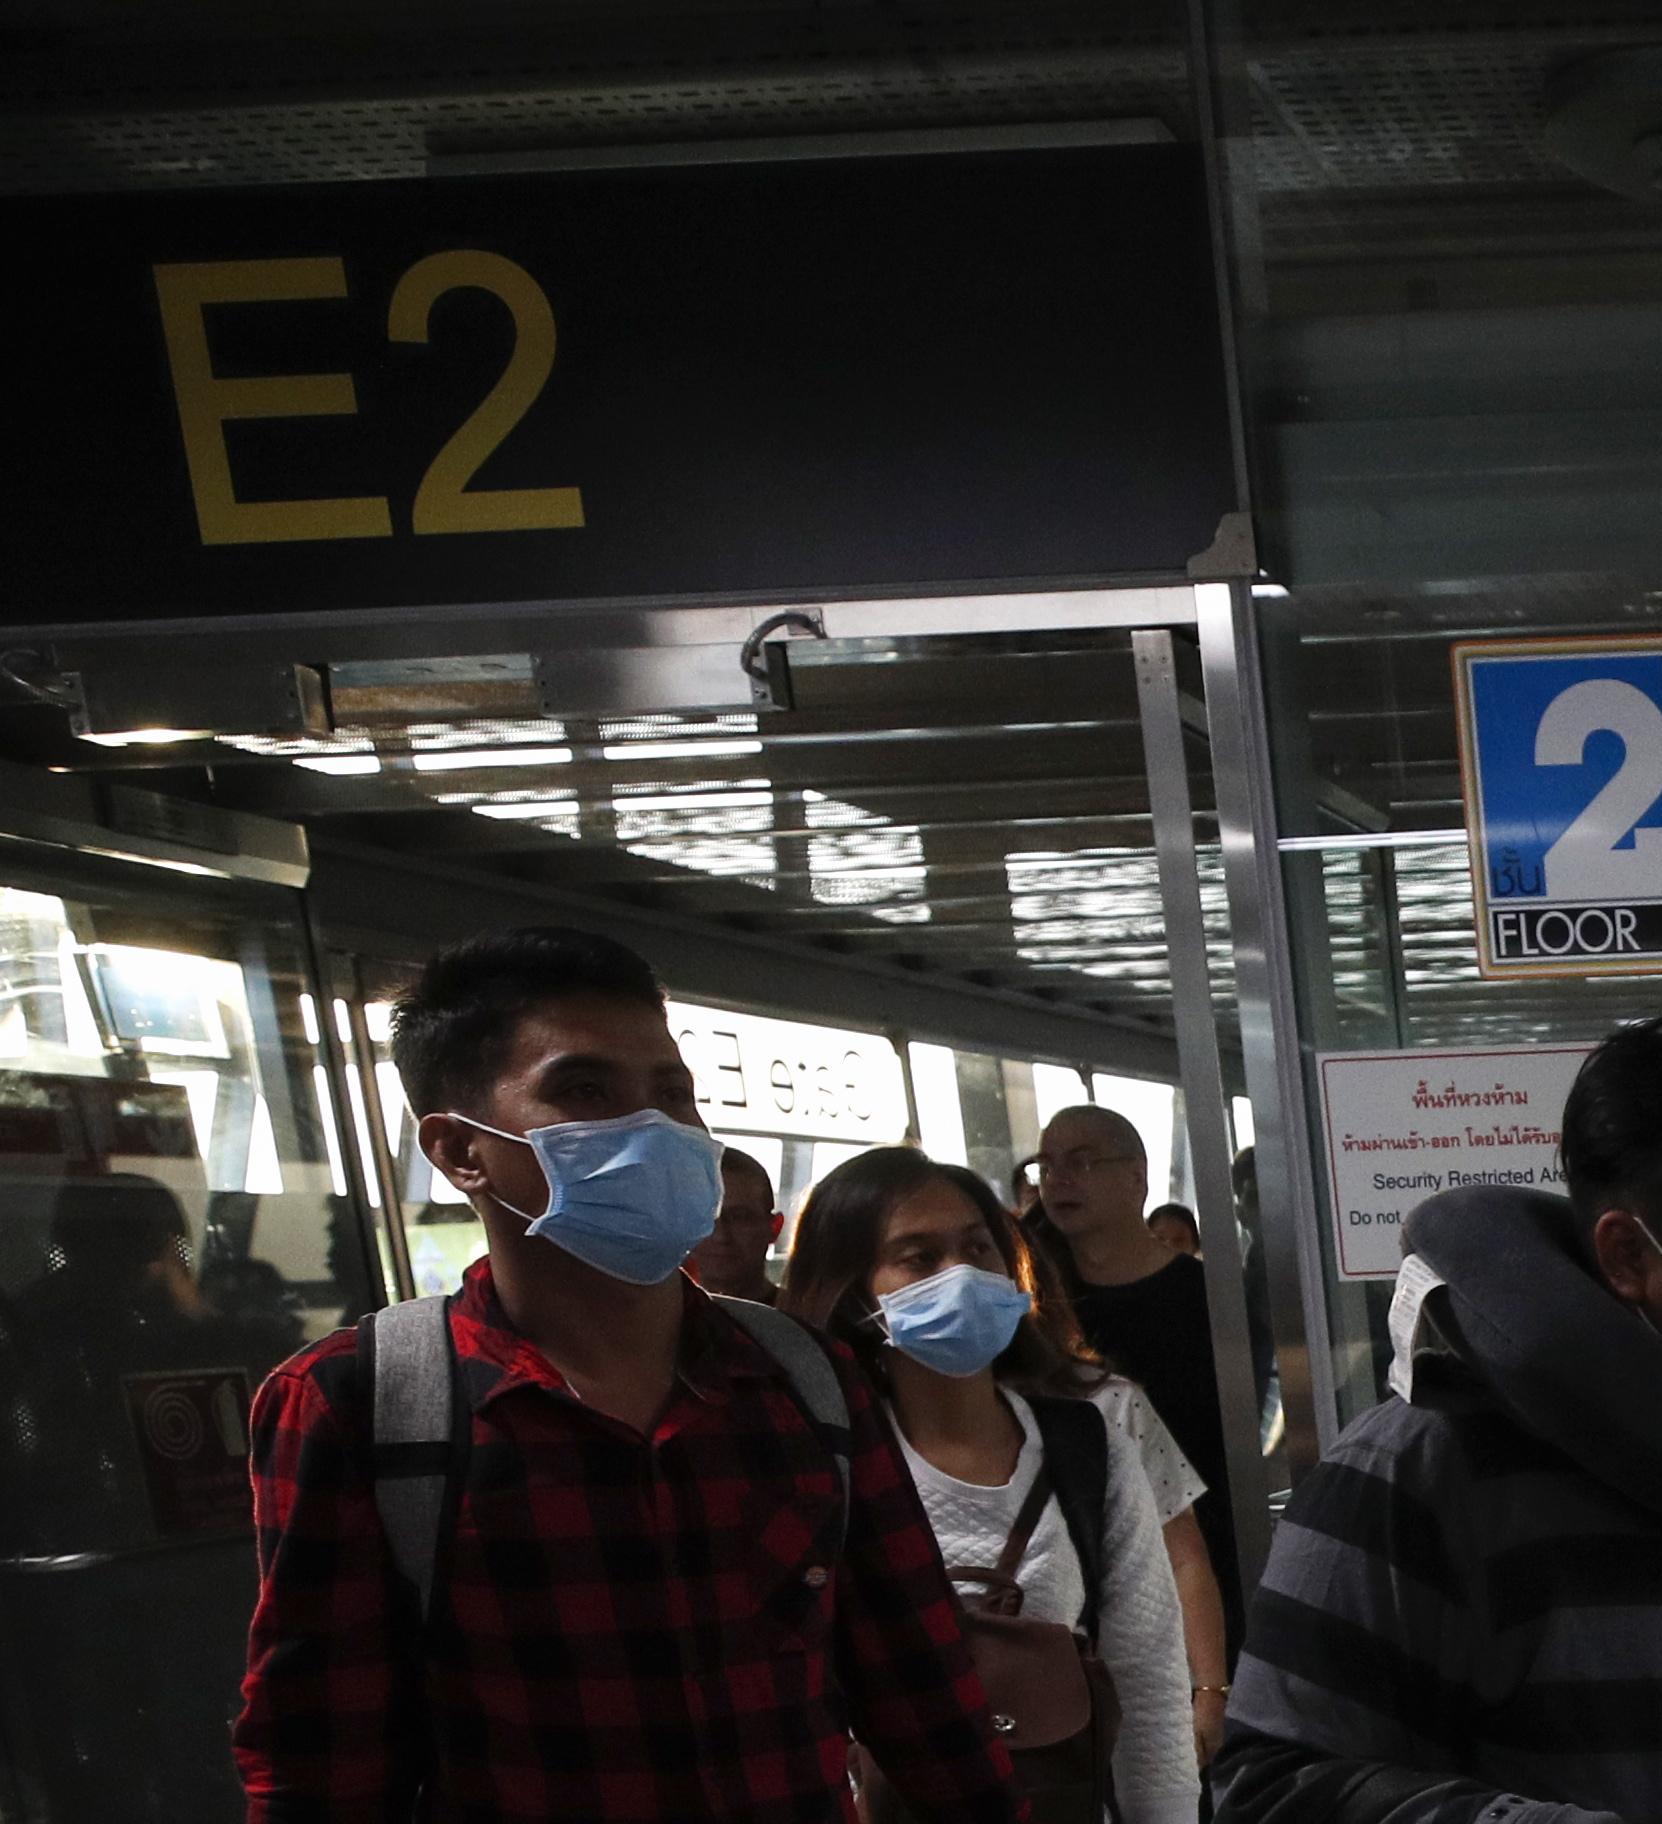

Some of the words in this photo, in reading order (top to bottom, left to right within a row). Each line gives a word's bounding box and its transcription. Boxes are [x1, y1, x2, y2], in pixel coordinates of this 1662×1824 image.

[152, 248, 587, 547] E2
[1493, 845, 1541, 896] ชั้น
[1496, 908, 1641, 957] FLOOR
[1412, 1079, 1528, 1109] พื้นที่หวงห้าม
[1341, 1130, 1461, 1152] ห้ามผ่านเข้า-ออก
[1465, 1125, 1562, 1148] โดยไม่ได้รับอ
[1373, 1172, 1442, 1191] Security
[1448, 1167, 1534, 1186] Restricted
[1540, 1167, 1568, 1183] Are
[1350, 1211, 1372, 1226] Do
[1376, 1211, 1401, 1225] not
